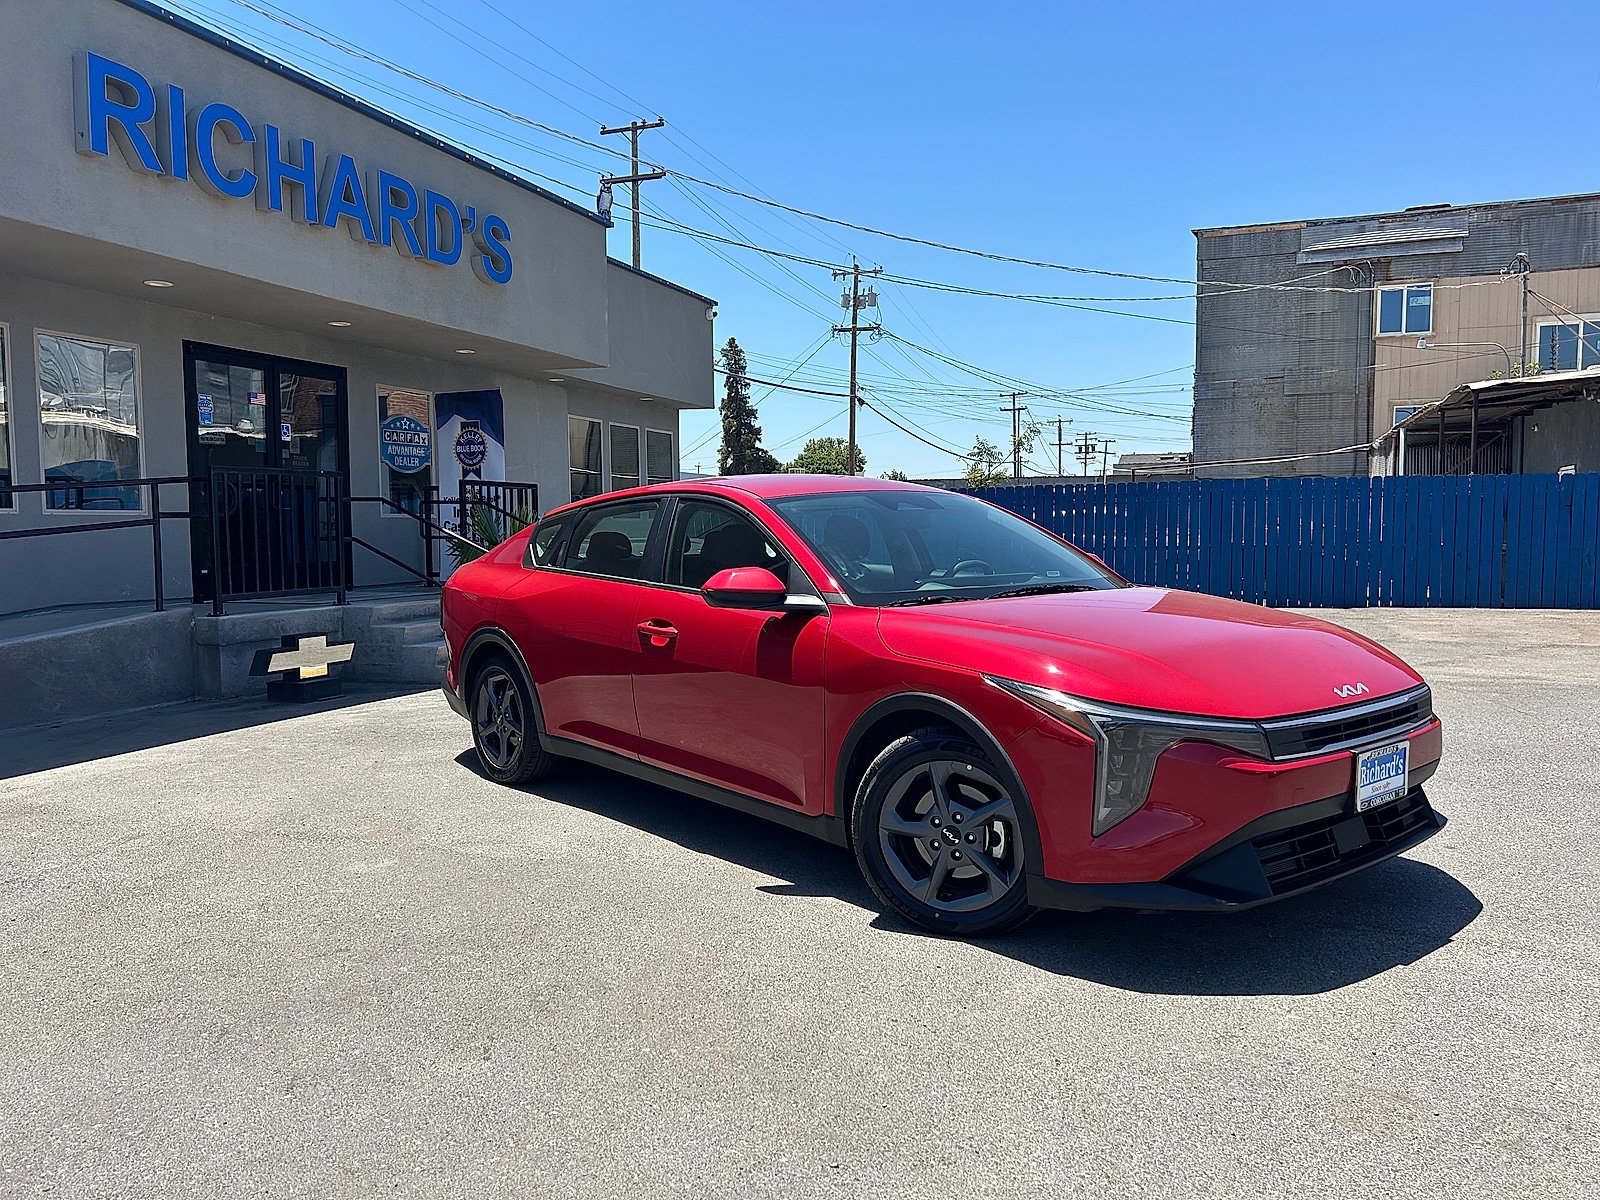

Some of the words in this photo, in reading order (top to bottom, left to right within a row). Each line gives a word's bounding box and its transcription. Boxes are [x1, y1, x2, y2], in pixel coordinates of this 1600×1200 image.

[86, 51, 514, 285] RICHARD'S
[384, 431, 428, 446] CARFAX
[459, 431, 482, 444] KELLEY
[387, 445, 425, 456] ADVANTAGE
[456, 445, 470, 453] BLUE
[470, 444, 485, 452] BOOK
[394, 456, 419, 466] DEALER
[1333, 682, 1369, 698] KIA
[1360, 755, 1404, 786] Richard's
